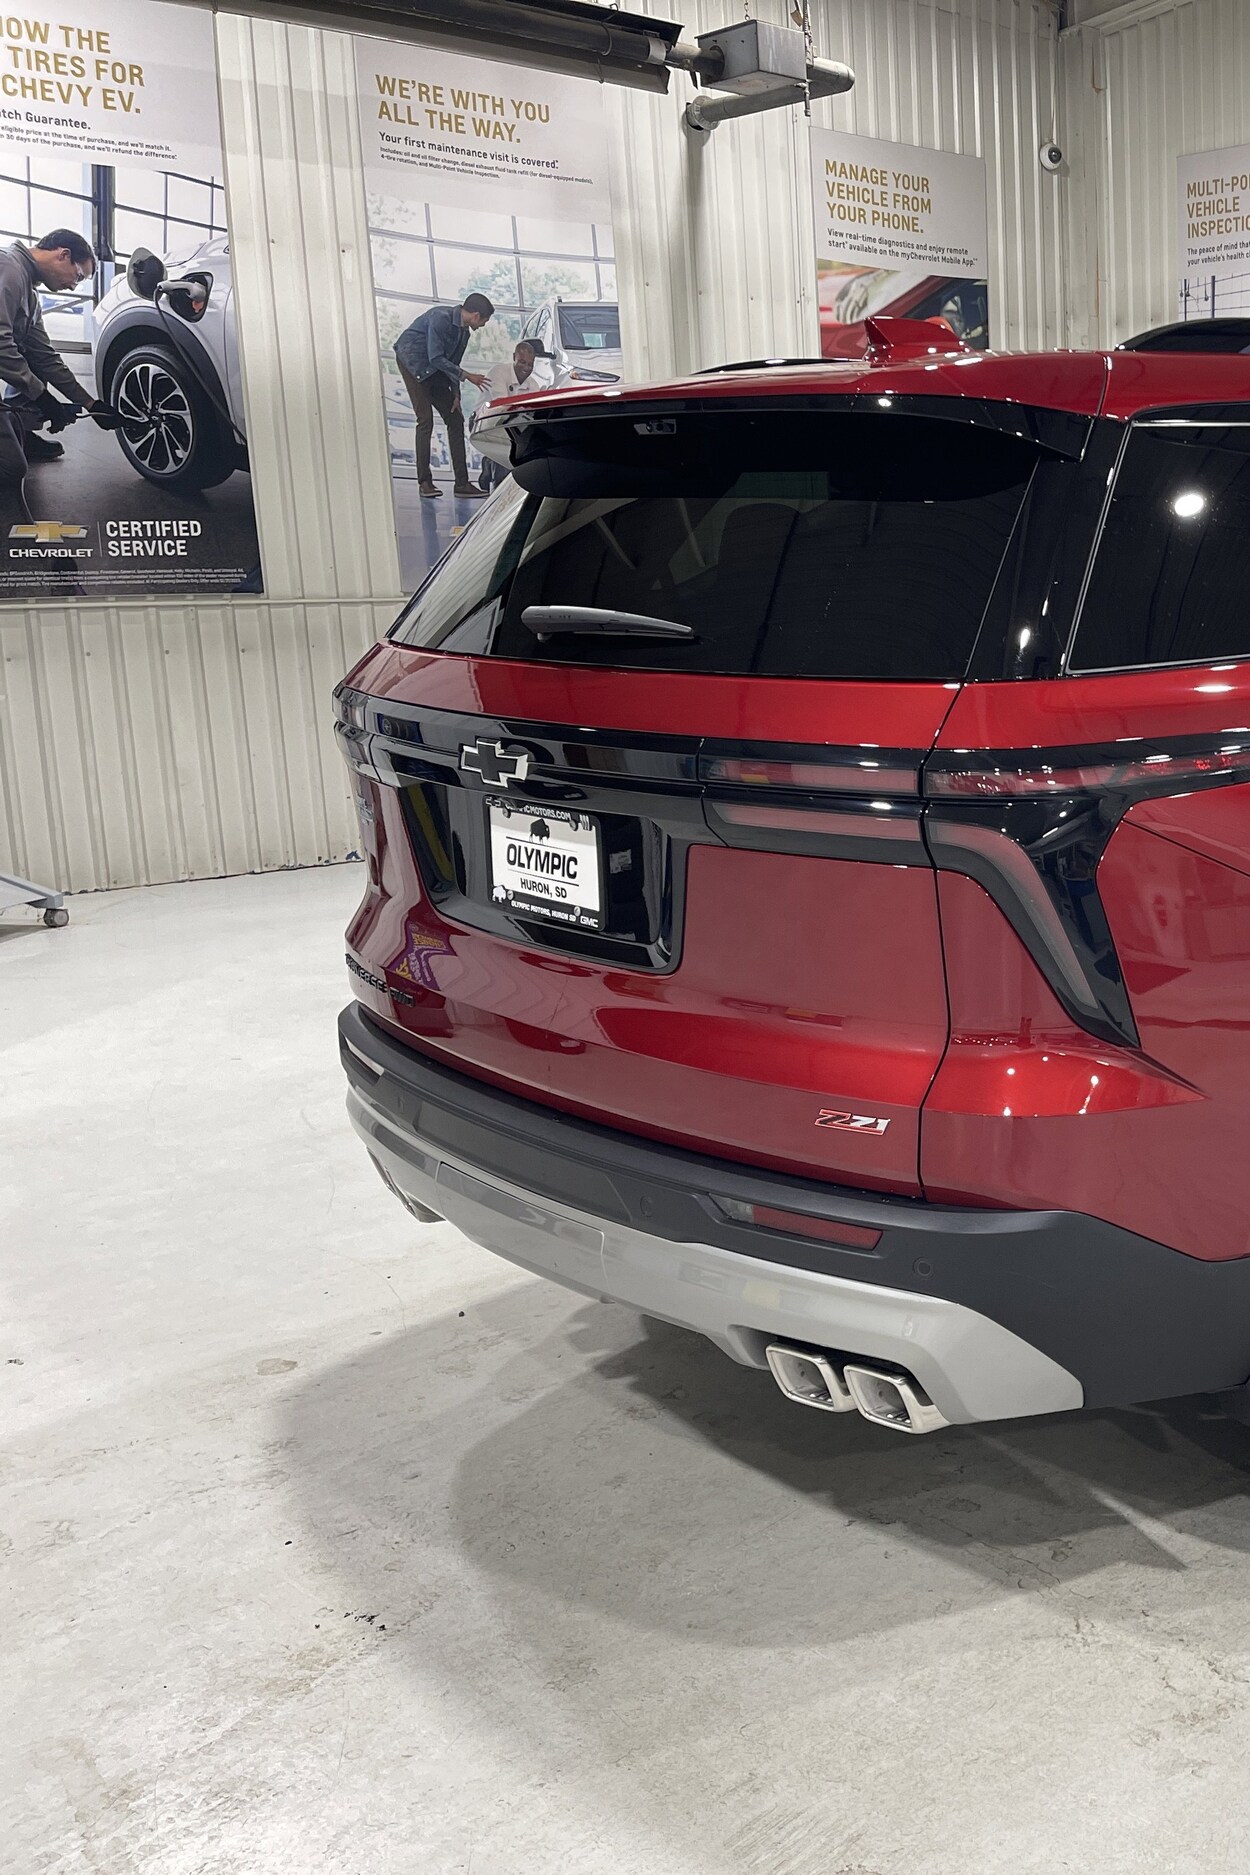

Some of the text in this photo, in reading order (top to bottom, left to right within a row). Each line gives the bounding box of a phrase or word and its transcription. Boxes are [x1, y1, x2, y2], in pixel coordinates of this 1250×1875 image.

[58, 25, 111, 54] THE
[7, 46, 145, 87] TIRES FOR
[2, 75, 141, 114] CHEVY EV.
[450, 88, 505, 117] WITH
[510, 99, 550, 124] YOU
[25, 112, 91, 130] Guarantee.
[378, 101, 521, 143] ALL THE WAY.
[379, 131, 401, 145] Your
[404, 136, 425, 149] first
[428, 141, 488, 160] maintenance
[489, 151, 509, 163] visit
[511, 153, 519, 164] is
[825, 159, 930, 194] MANAGE YOUR
[825, 180, 932, 215] VEHICLE FROM
[1187, 196, 1240, 219] VEHICLE
[826, 202, 924, 234] YOUR PHONE.
[827, 228, 969, 256] View real-time diagnostics and enjoy remote
[849, 243, 878, 255] available
[889, 249, 900, 257] the
[900, 252, 941, 264] myChevrolet
[941, 255, 961, 265] Mobile
[1187, 247, 1198, 256] The
[1198, 246, 1216, 256] peace
[1216, 244, 1223, 252] of
[1223, 241, 1238, 251] mind
[1187, 258, 1200, 267] your
[1201, 254, 1225, 264] vehicle's
[1226, 252, 1245, 262] health
[106, 520, 202, 538] CERTIFIED
[9, 548, 94, 559] CHEVROLET
[108, 540, 188, 557] SERVICE
[506, 843, 578, 879] OLYMPIC
[520, 878, 567, 899] HURON, SD
[580, 915, 598, 928] GMC
[814, 1108, 891, 1136] Z71
